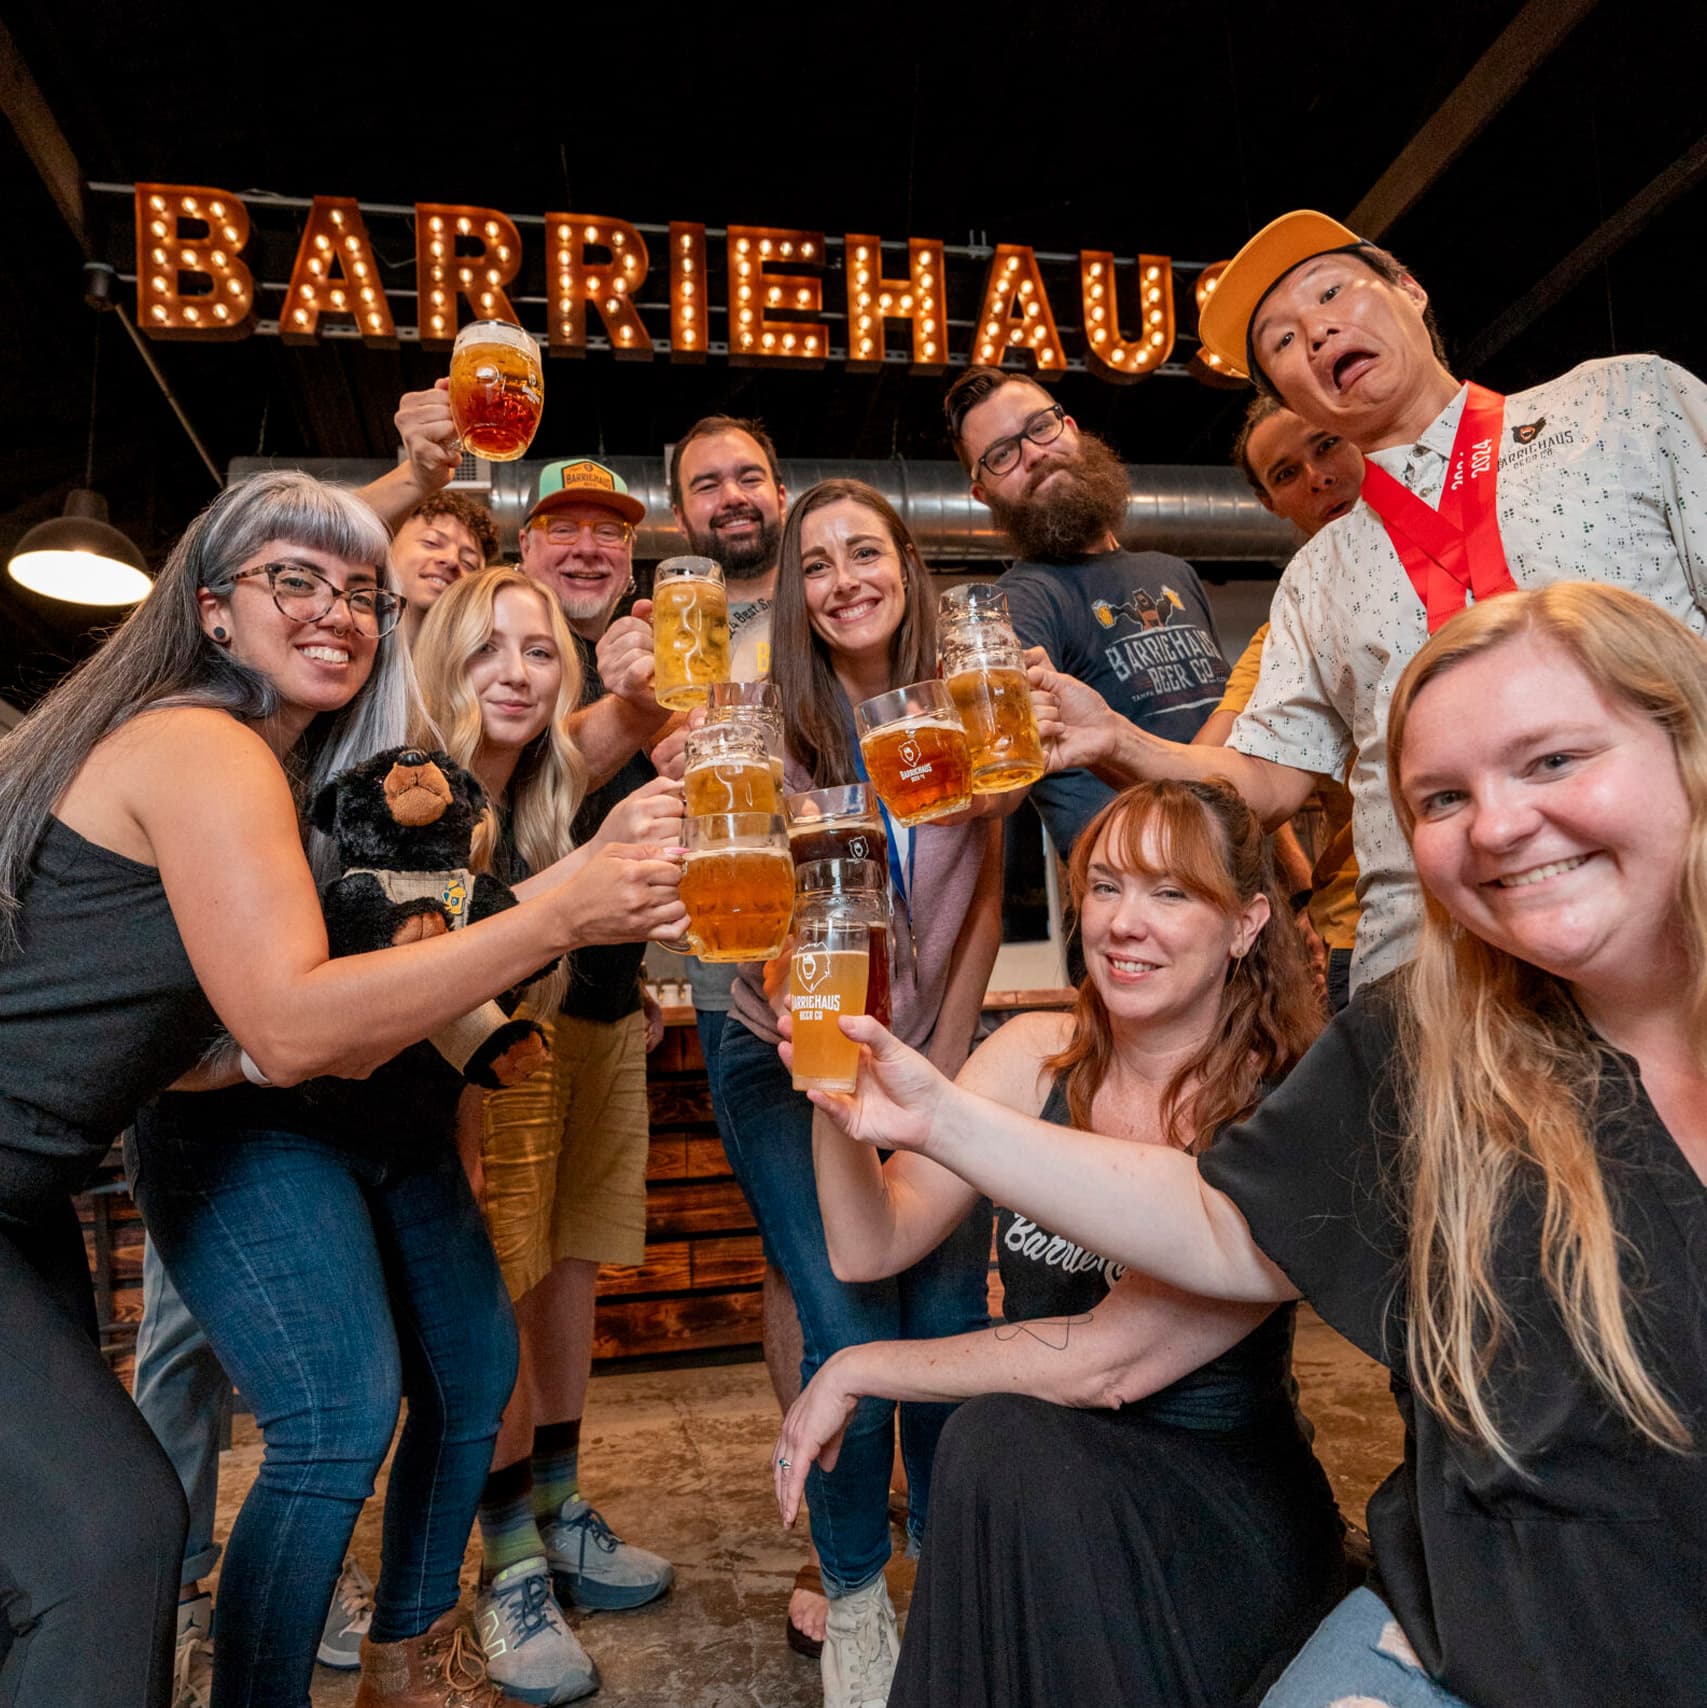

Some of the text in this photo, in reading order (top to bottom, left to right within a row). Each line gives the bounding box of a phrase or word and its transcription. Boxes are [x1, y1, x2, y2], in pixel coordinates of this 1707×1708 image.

[1471, 438, 1493, 479] 2024
[733, 604, 760, 624] Best
[1148, 664, 1195, 695] BEER
